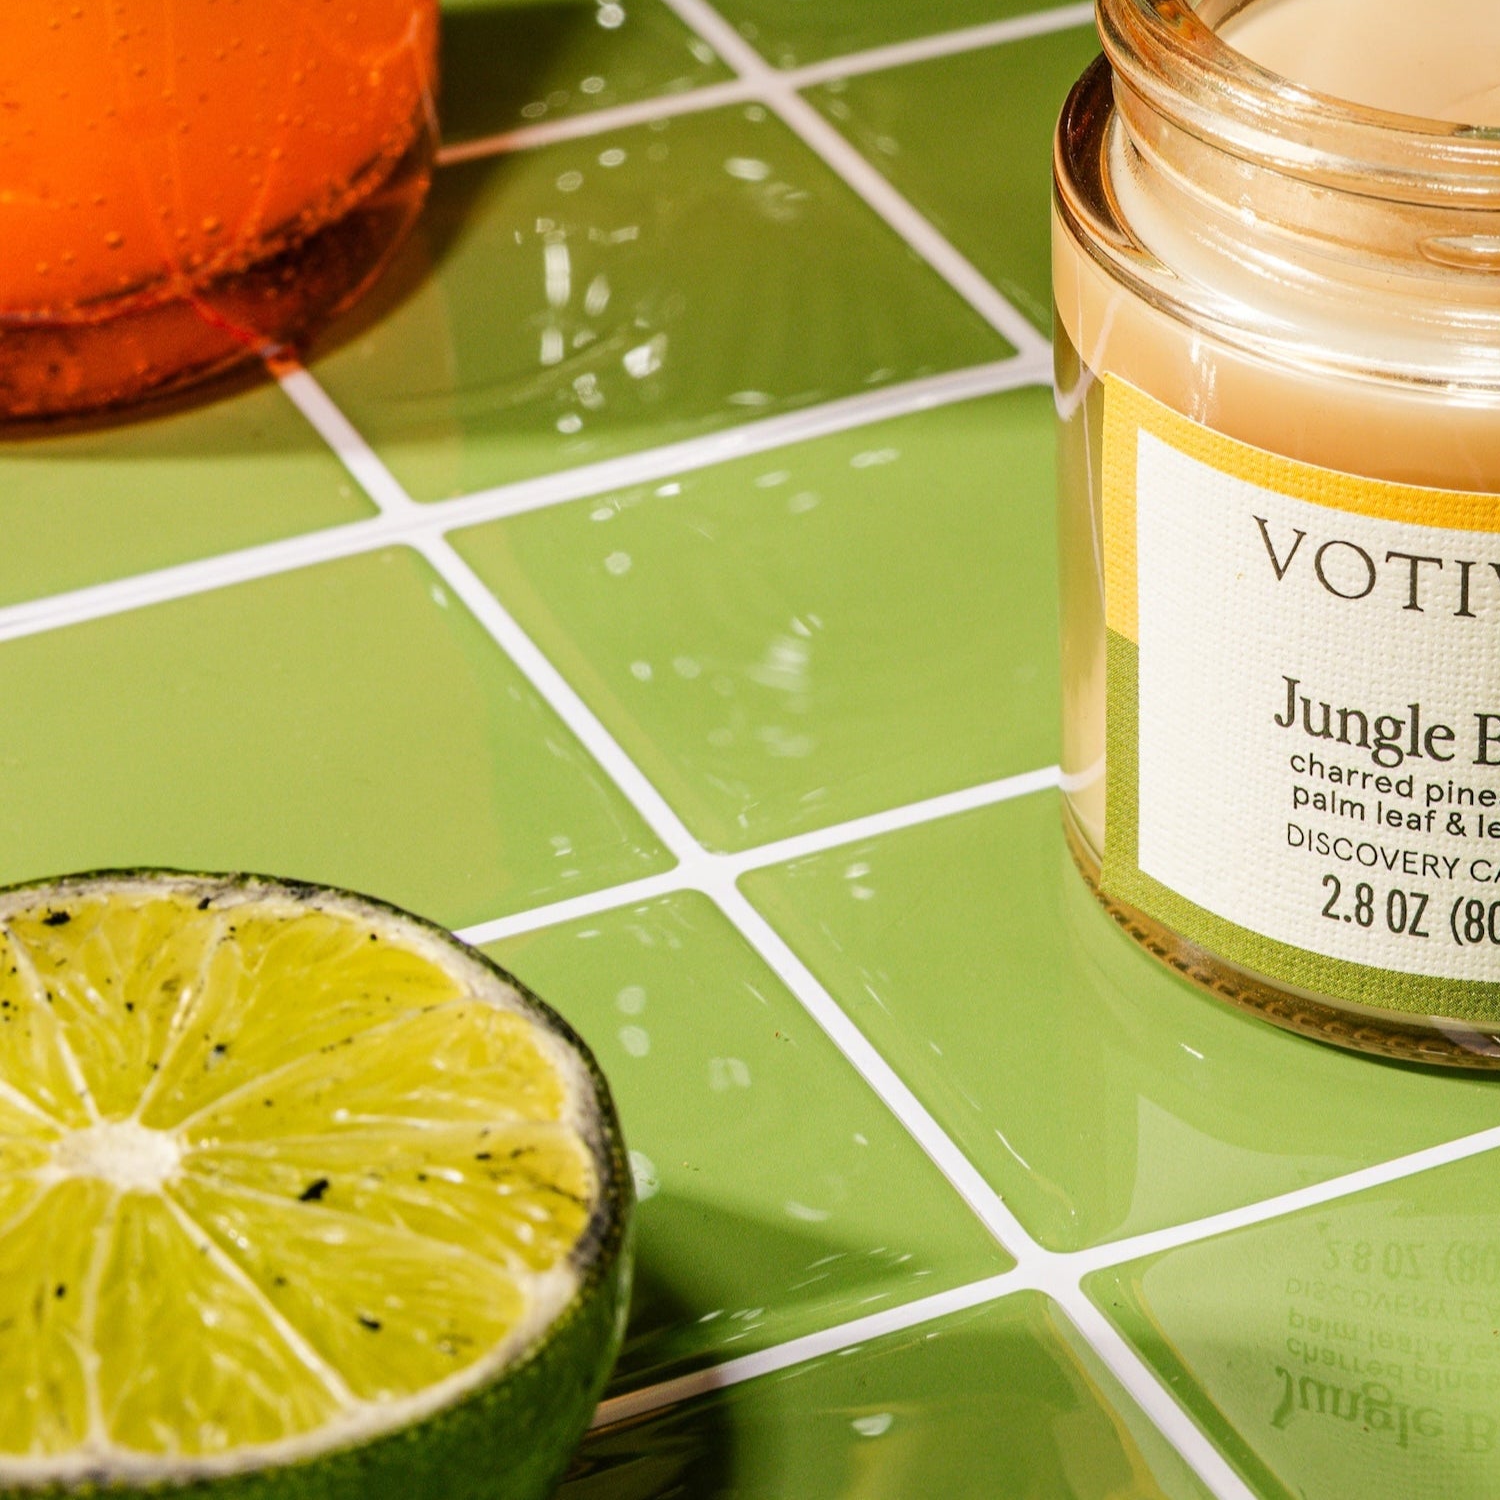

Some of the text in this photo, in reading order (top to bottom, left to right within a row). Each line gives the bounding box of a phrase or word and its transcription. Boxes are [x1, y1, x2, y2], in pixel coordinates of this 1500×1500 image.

[1273, 675, 1456, 768] Jungle
[1290, 752, 1413, 799] charred
[1292, 785, 1366, 821] palm
[1377, 800, 1437, 832] leaf
[1445, 812, 1467, 837] &
[1286, 822, 1461, 879] DISCOVERY
[1320, 873, 1375, 928] 2.8
[1386, 888, 1430, 938] OZ
